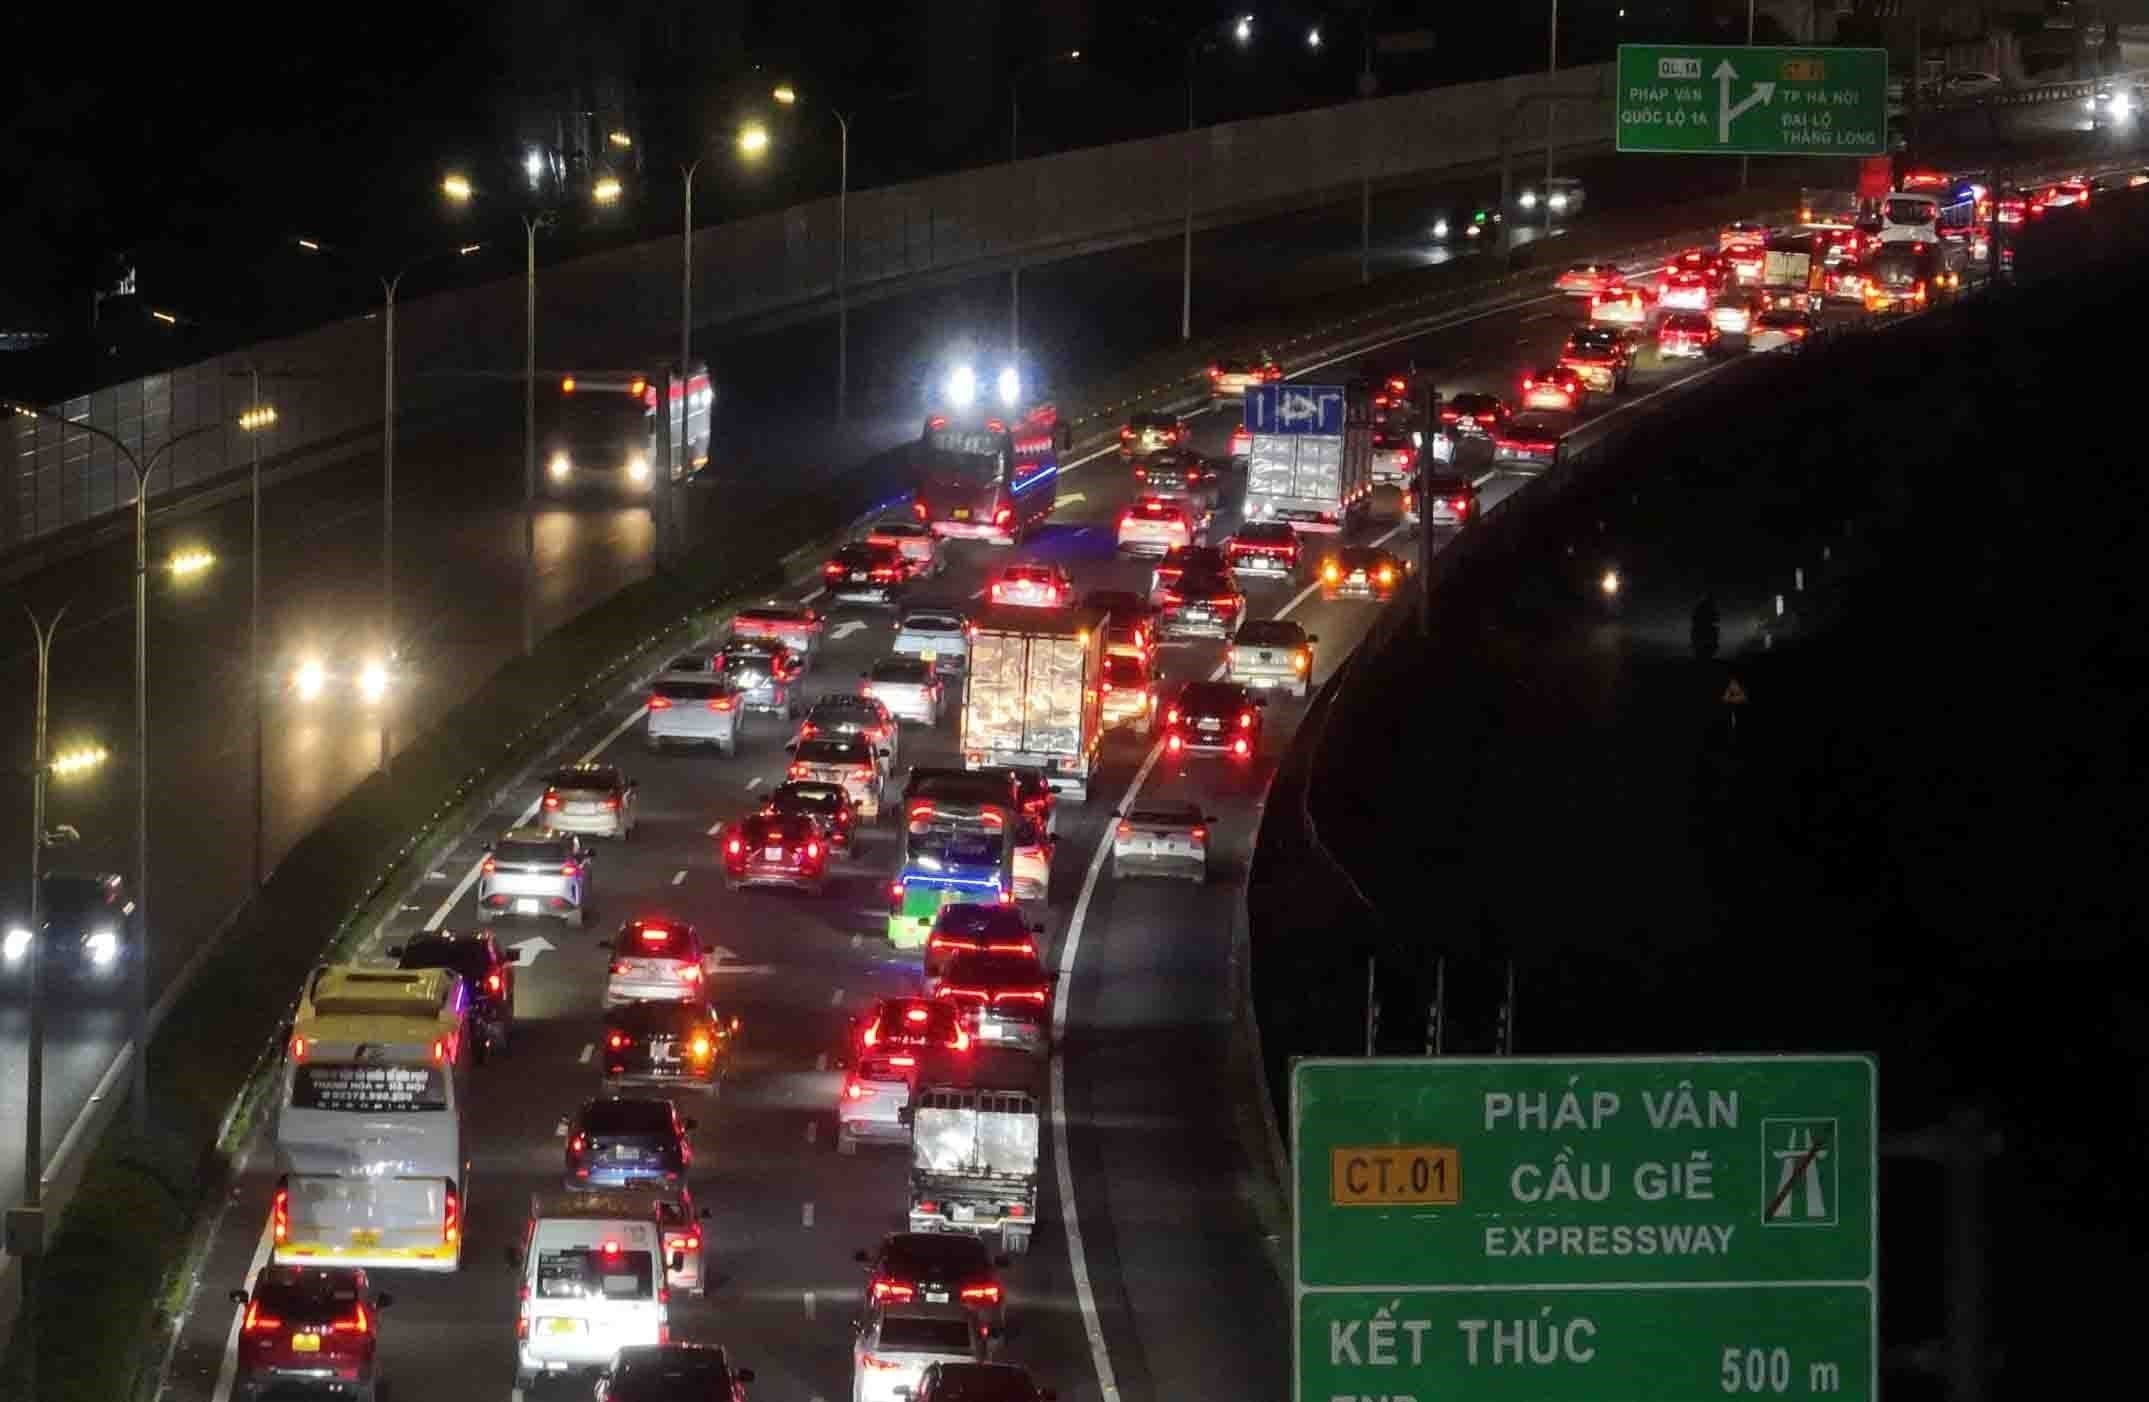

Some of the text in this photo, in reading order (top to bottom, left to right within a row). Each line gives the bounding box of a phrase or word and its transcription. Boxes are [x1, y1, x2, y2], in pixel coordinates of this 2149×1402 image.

[1690, 111, 1709, 125] 1A
[1836, 129, 1876, 145] LONG
[1484, 1076, 1739, 1131] PHÁP VÂN
[1345, 1156, 1447, 1194] CT.01
[1510, 1145, 1714, 1202] CẦU GIẼ
[1484, 1224, 1735, 1257] EXPRESSWAY
[1329, 1299, 1598, 1366] KẾT THÚC
[1720, 1347, 1839, 1393] 500 m
